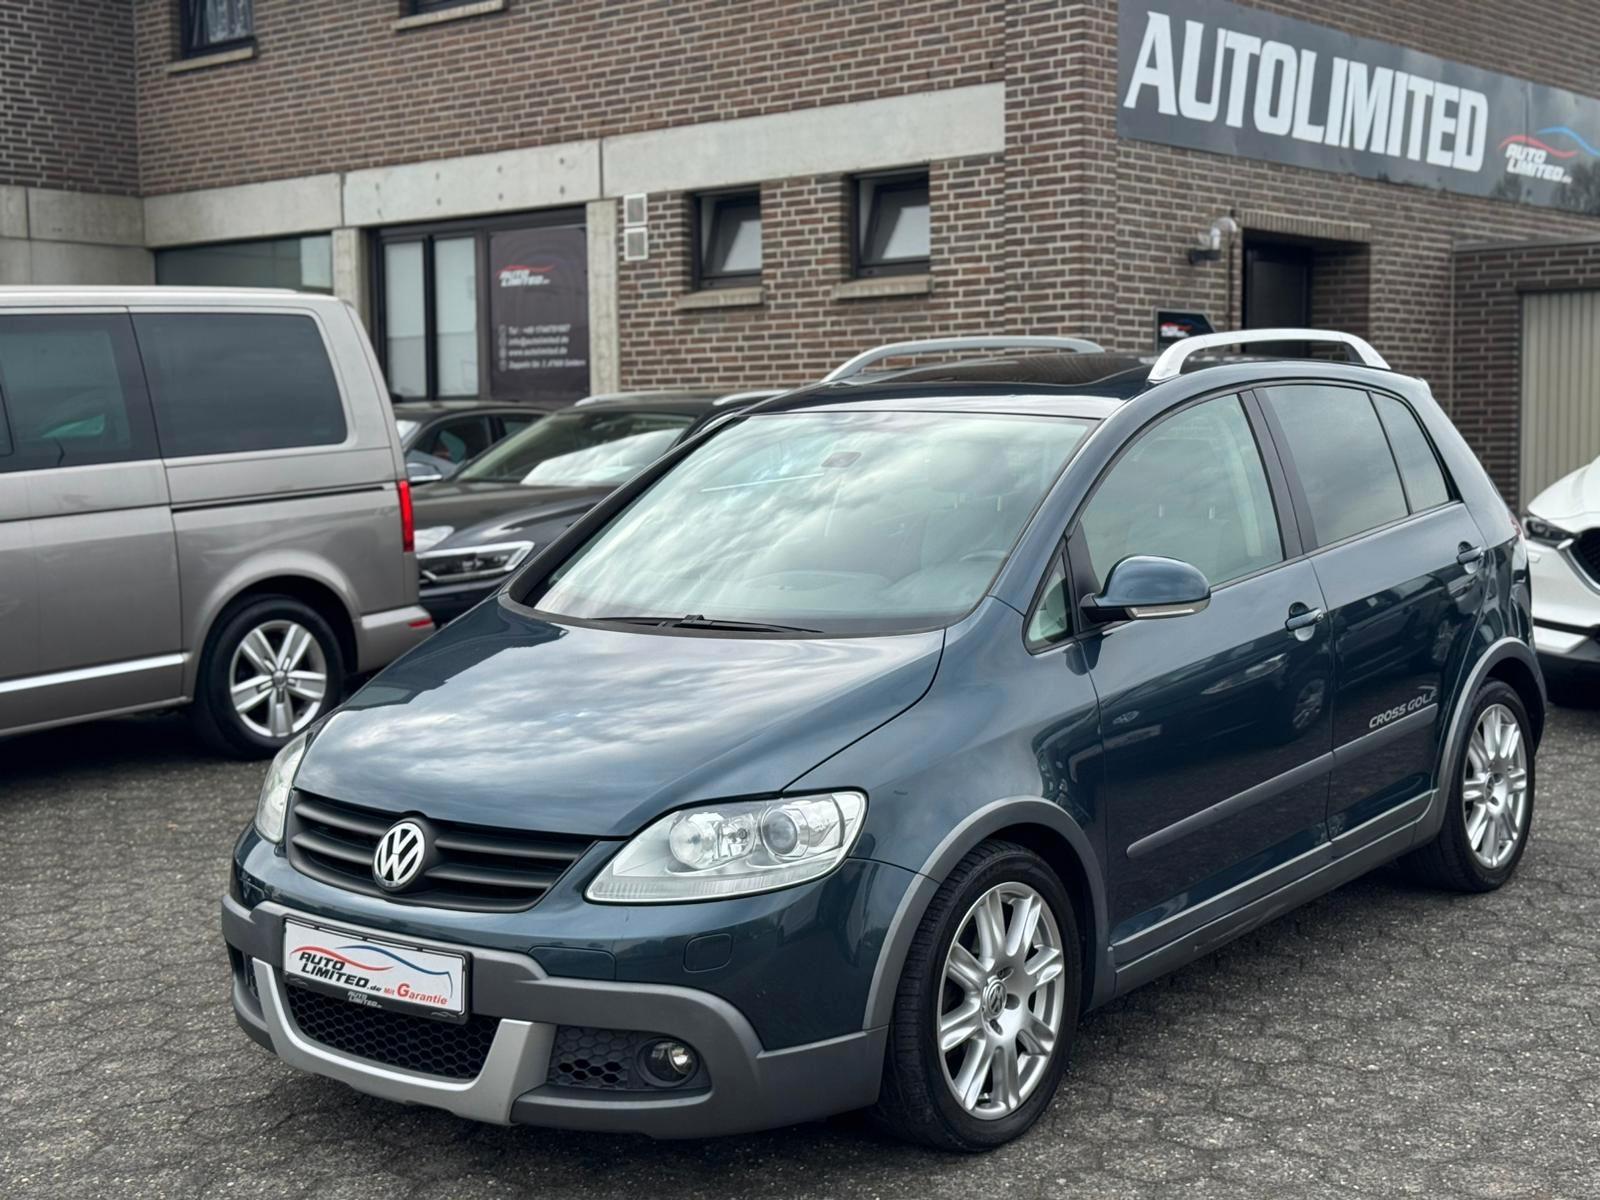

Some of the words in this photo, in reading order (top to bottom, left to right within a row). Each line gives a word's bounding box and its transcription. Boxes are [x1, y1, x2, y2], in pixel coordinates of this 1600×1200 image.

[1123, 10, 1489, 173] AUTOLIMITED
[1505, 143, 1548, 164] AUTO
[1369, 703, 1407, 729] CROSS
[1407, 685, 1438, 712] GOLF
[299, 951, 346, 971] AUTO
[301, 963, 382, 993] LIMITED.de
[383, 987, 395, 996] Mit
[397, 983, 449, 1005] Garantie
